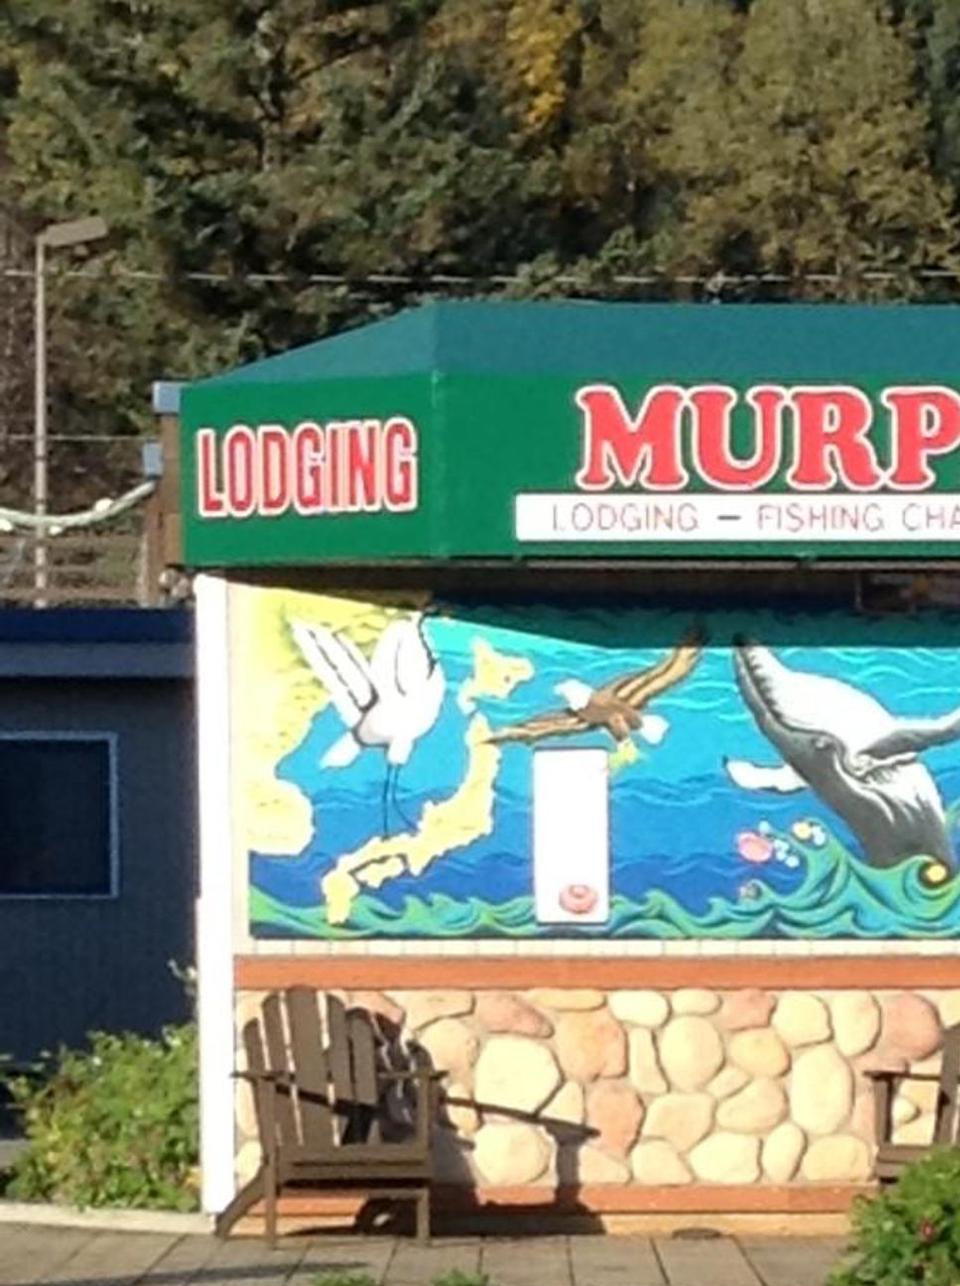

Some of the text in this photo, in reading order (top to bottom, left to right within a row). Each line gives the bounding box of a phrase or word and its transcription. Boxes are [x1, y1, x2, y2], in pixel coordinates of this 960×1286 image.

[194, 416, 420, 518] LODGING
[552, 502, 699, 533] LODGING
[757, 502, 886, 533] FISHING
